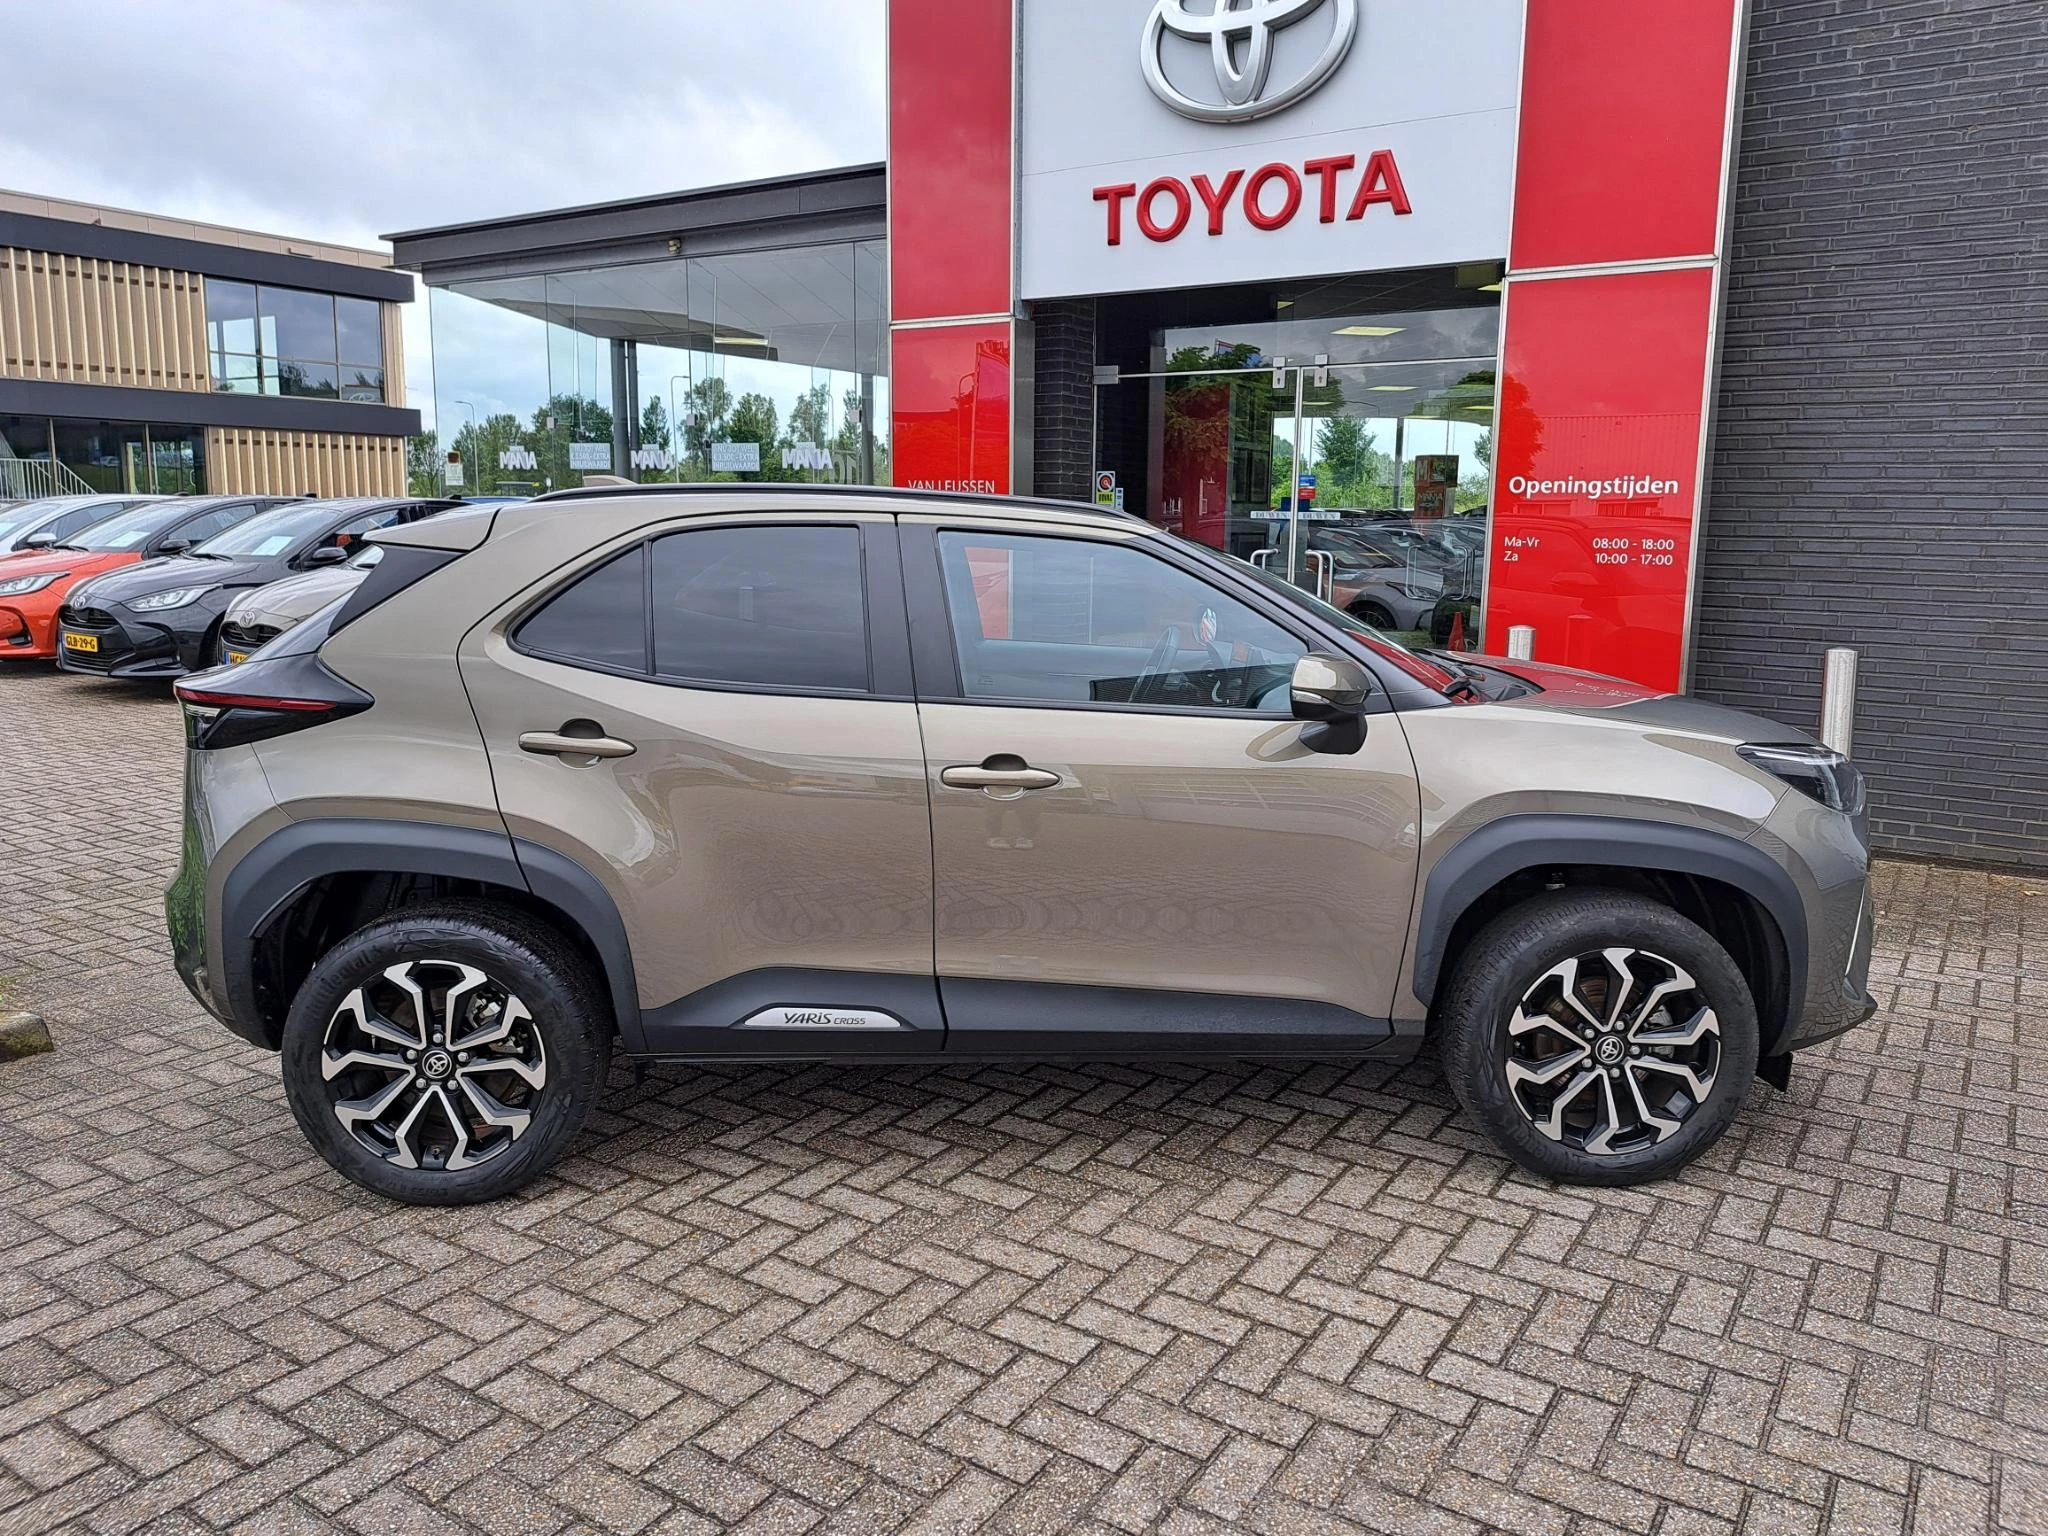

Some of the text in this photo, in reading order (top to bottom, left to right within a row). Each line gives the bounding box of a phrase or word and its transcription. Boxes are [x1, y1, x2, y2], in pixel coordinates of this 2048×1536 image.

[1093, 149, 1412, 246] TOYOTA
[499, 451, 538, 470] MANIA
[630, 450, 676, 470] MANIA
[782, 448, 833, 470] MANIA
[908, 480, 934, 490] VAN
[1509, 475, 1678, 499] Openingstijden
[1504, 536, 1540, 548] Ma-Vr
[1592, 538, 1629, 549] 08:00
[1641, 538, 1675, 551] 18:00
[1504, 551, 1519, 562] Za
[1595, 553, 1628, 565] 10:00
[1640, 554, 1673, 566] 17:00
[833, 1017, 866, 1025] CROSS
